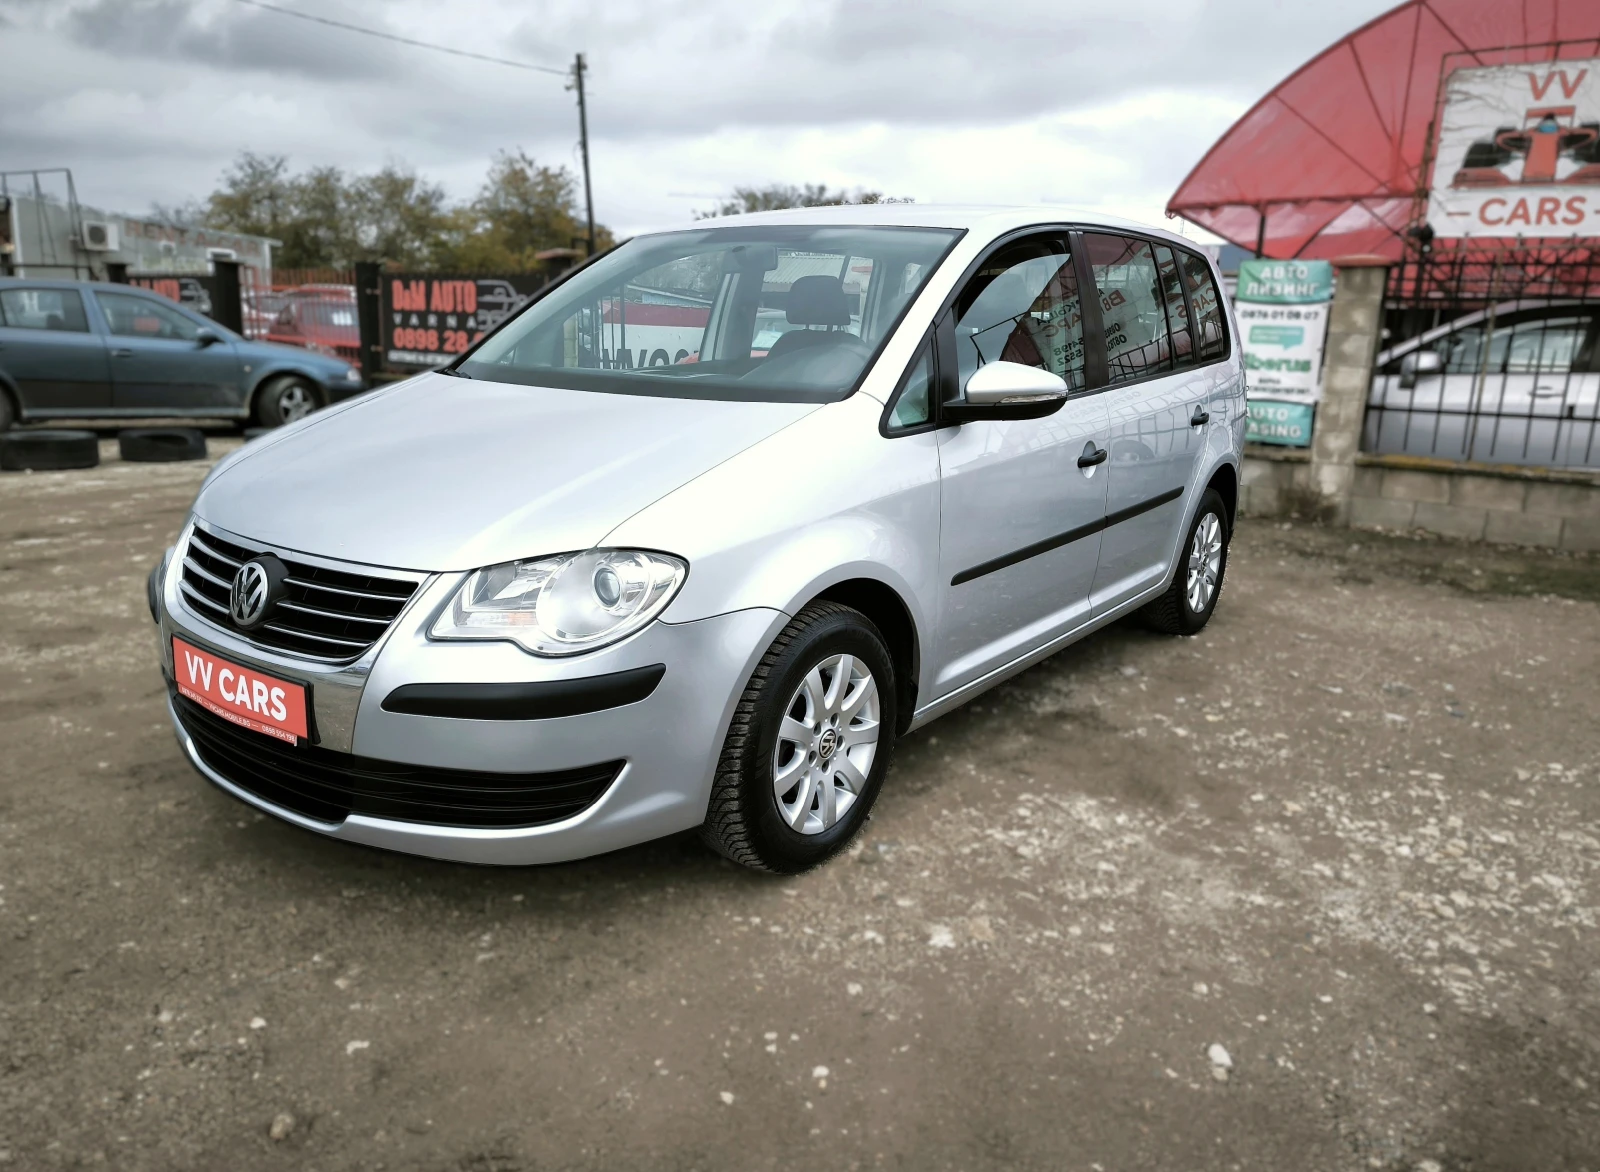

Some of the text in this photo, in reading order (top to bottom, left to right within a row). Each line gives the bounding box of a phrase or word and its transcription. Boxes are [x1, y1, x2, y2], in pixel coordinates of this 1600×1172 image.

[1528, 68, 1588, 101] VV
[1478, 196, 1588, 227] CARS
[1259, 265, 1309, 280] АВТО
[430, 279, 478, 314] AUTO
[1246, 281, 1320, 297] ЛИЗИНГ
[393, 313, 477, 329] VARNA
[393, 328, 439, 350] 0898
[185, 650, 287, 722] VV CARS
